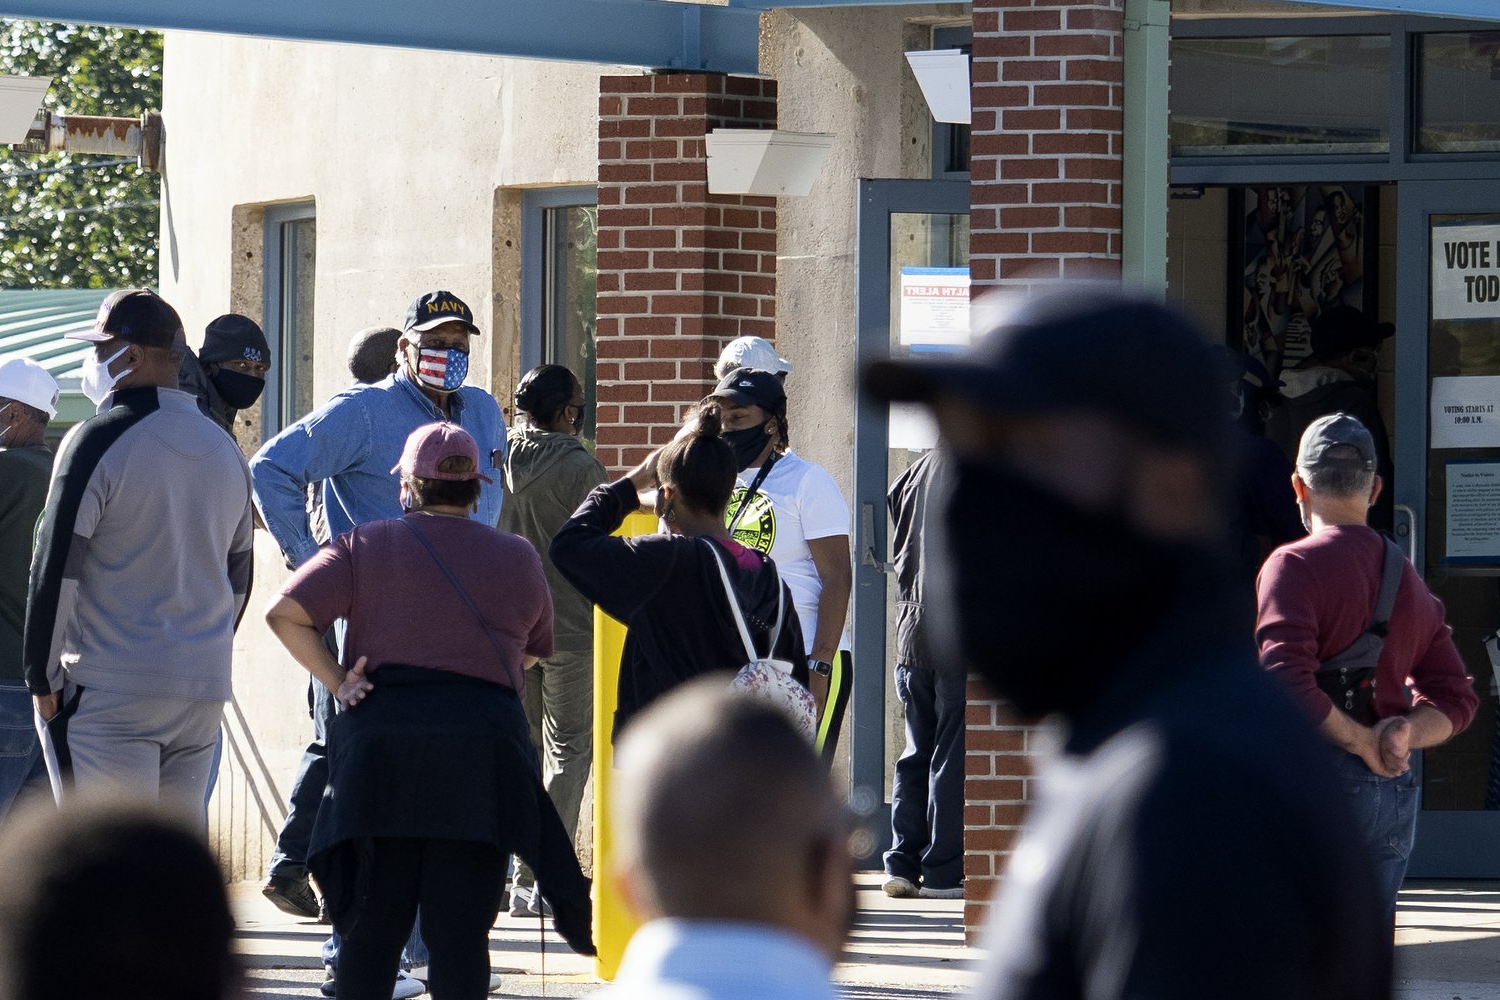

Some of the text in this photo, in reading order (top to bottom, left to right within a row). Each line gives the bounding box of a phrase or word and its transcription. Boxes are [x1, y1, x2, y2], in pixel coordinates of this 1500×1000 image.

[1444, 241, 1490, 269] VOTE
[1464, 275, 1500, 303] TOD
[427, 300, 465, 315] NAVY
[1443, 404, 1494, 414] VOTING STARTS AT
